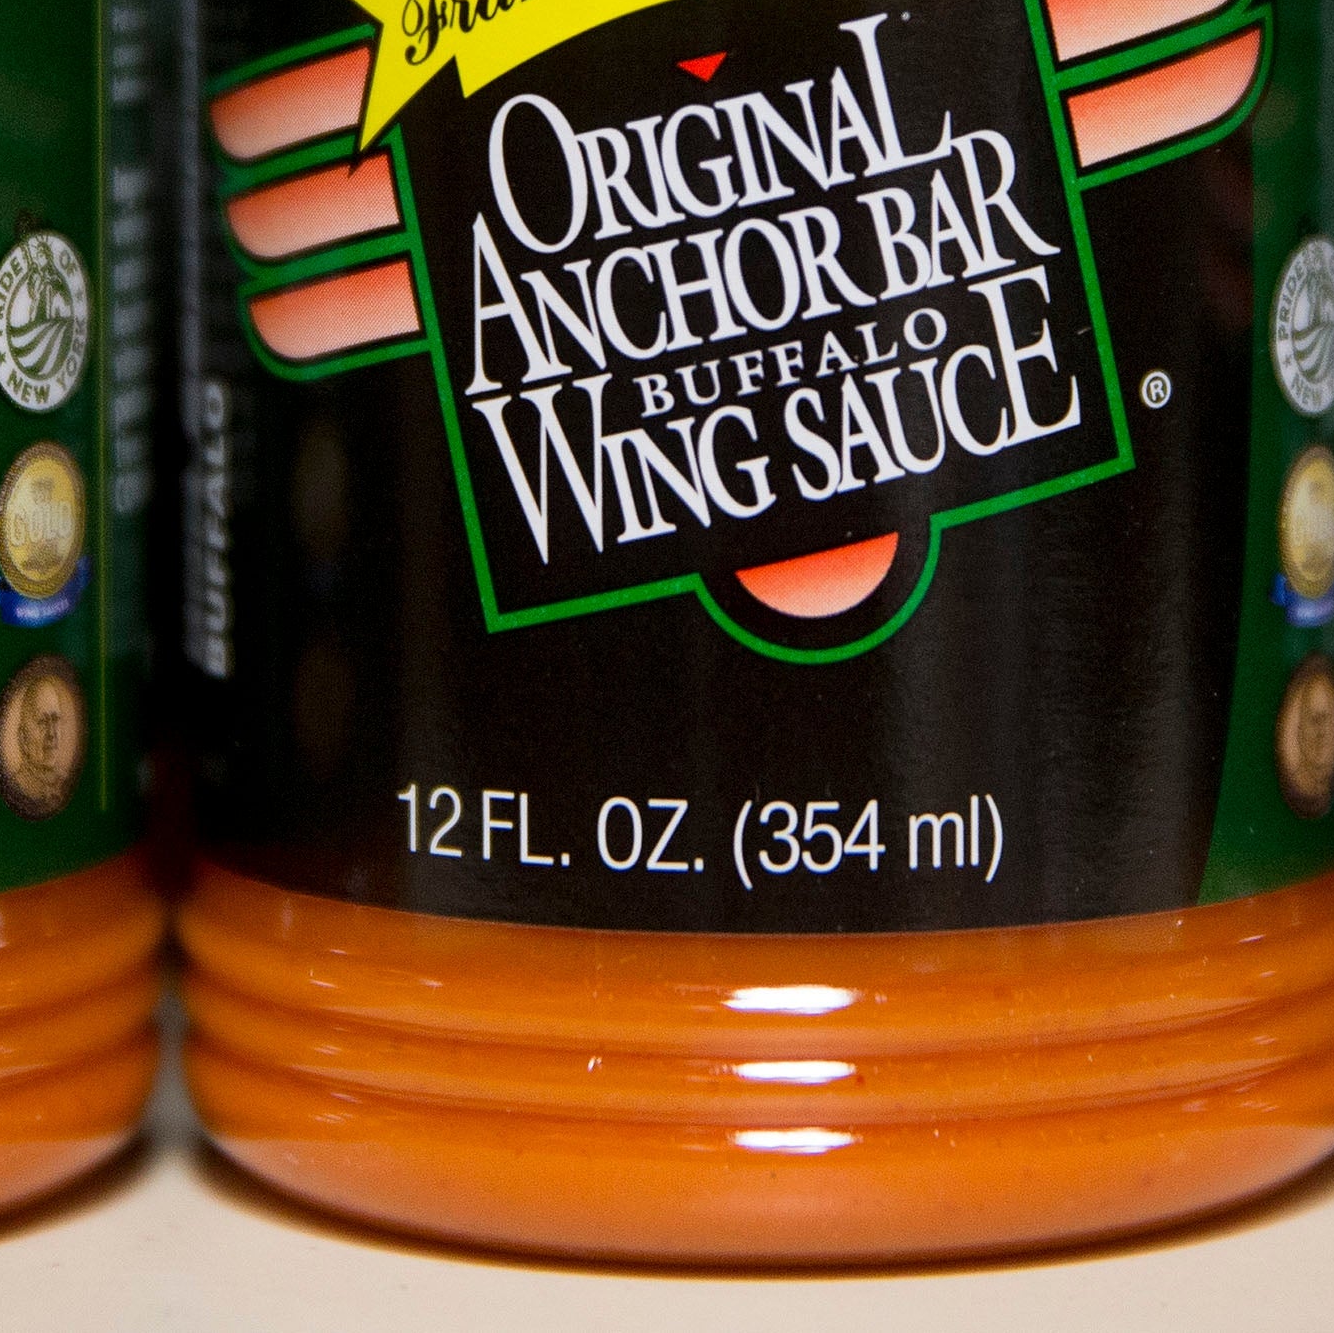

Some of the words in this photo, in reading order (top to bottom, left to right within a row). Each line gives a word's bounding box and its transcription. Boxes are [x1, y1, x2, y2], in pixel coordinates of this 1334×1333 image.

[487, 12, 952, 254] ORIGINAL
[465, 206, 876, 396] ANCHOR
[857, 128, 1061, 301] BAR
[6, 369, 52, 406] NEW
[55, 317, 85, 393] YORK
[473, 373, 776, 564] WING
[784, 265, 1081, 502] SAUCE
[633, 307, 947, 419] BUFFALO
[398, 783, 462, 858] 12
[482, 789, 570, 866] FL.
[597, 797, 704, 872] OZ.
[733, 799, 885, 891] (354
[908, 794, 1003, 883] ml)
